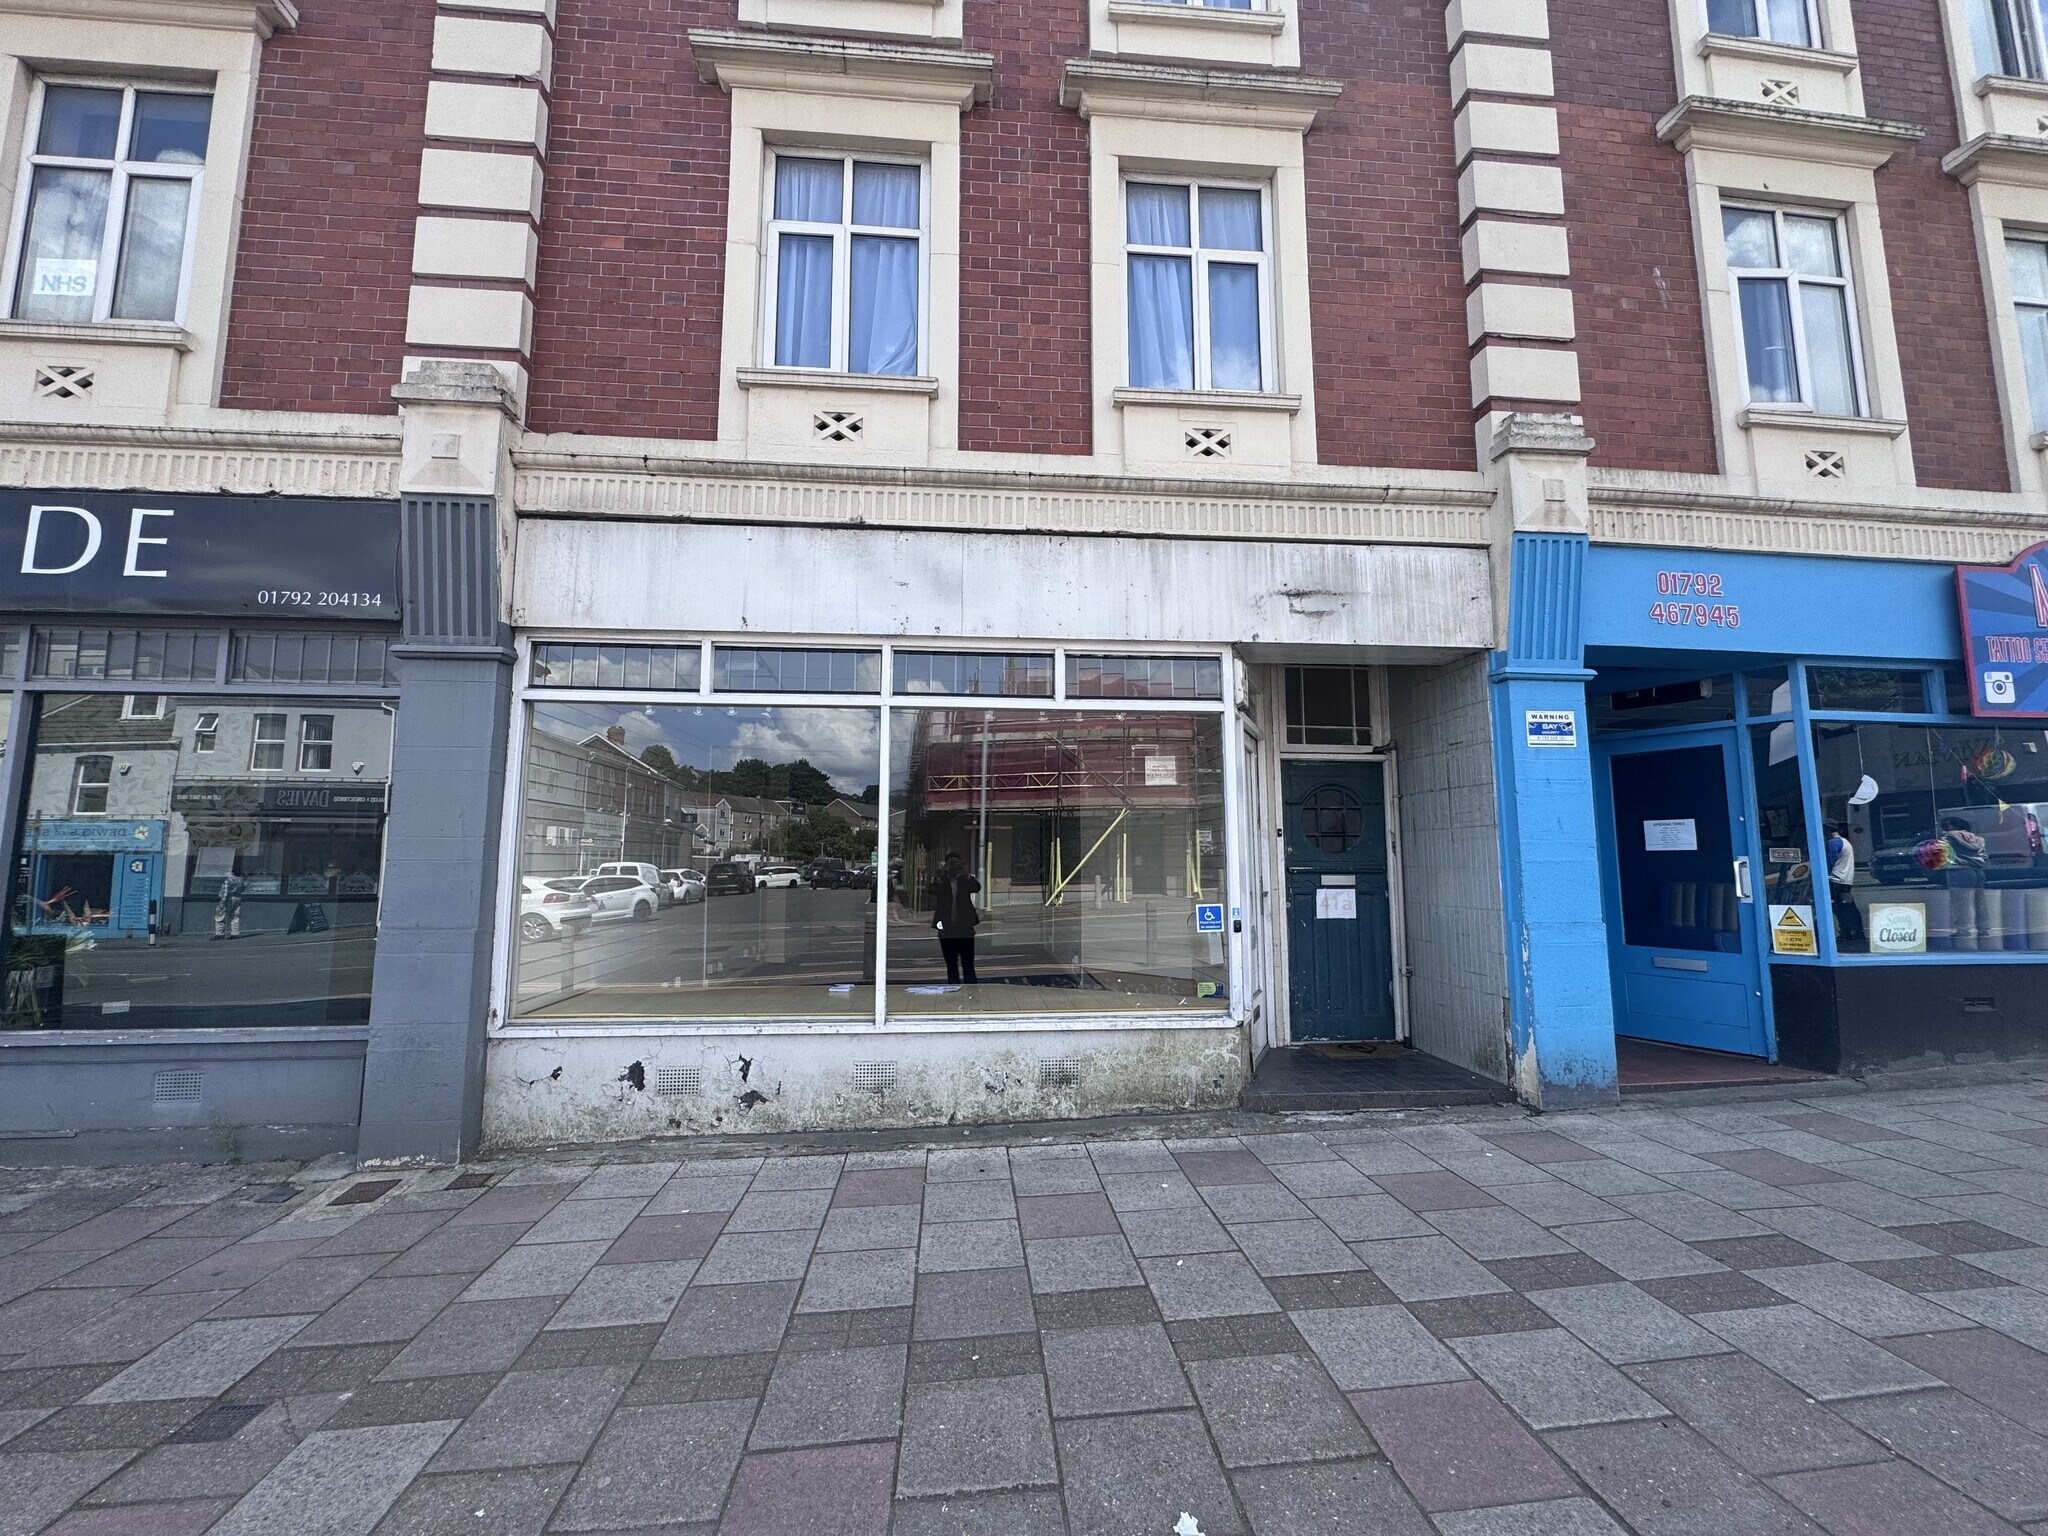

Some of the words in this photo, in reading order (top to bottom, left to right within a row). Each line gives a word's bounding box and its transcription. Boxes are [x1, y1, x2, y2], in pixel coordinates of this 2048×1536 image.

[40, 274, 87, 293] NHS
[1656, 571, 1724, 597] 01792
[257, 590, 312, 606] 01792
[317, 591, 382, 607] 204134
[1649, 602, 1740, 628] 467945
[1985, 636, 2032, 663] TATTOO
[1320, 895, 1352, 911] 41a
[1879, 927, 1918, 943] Closed
